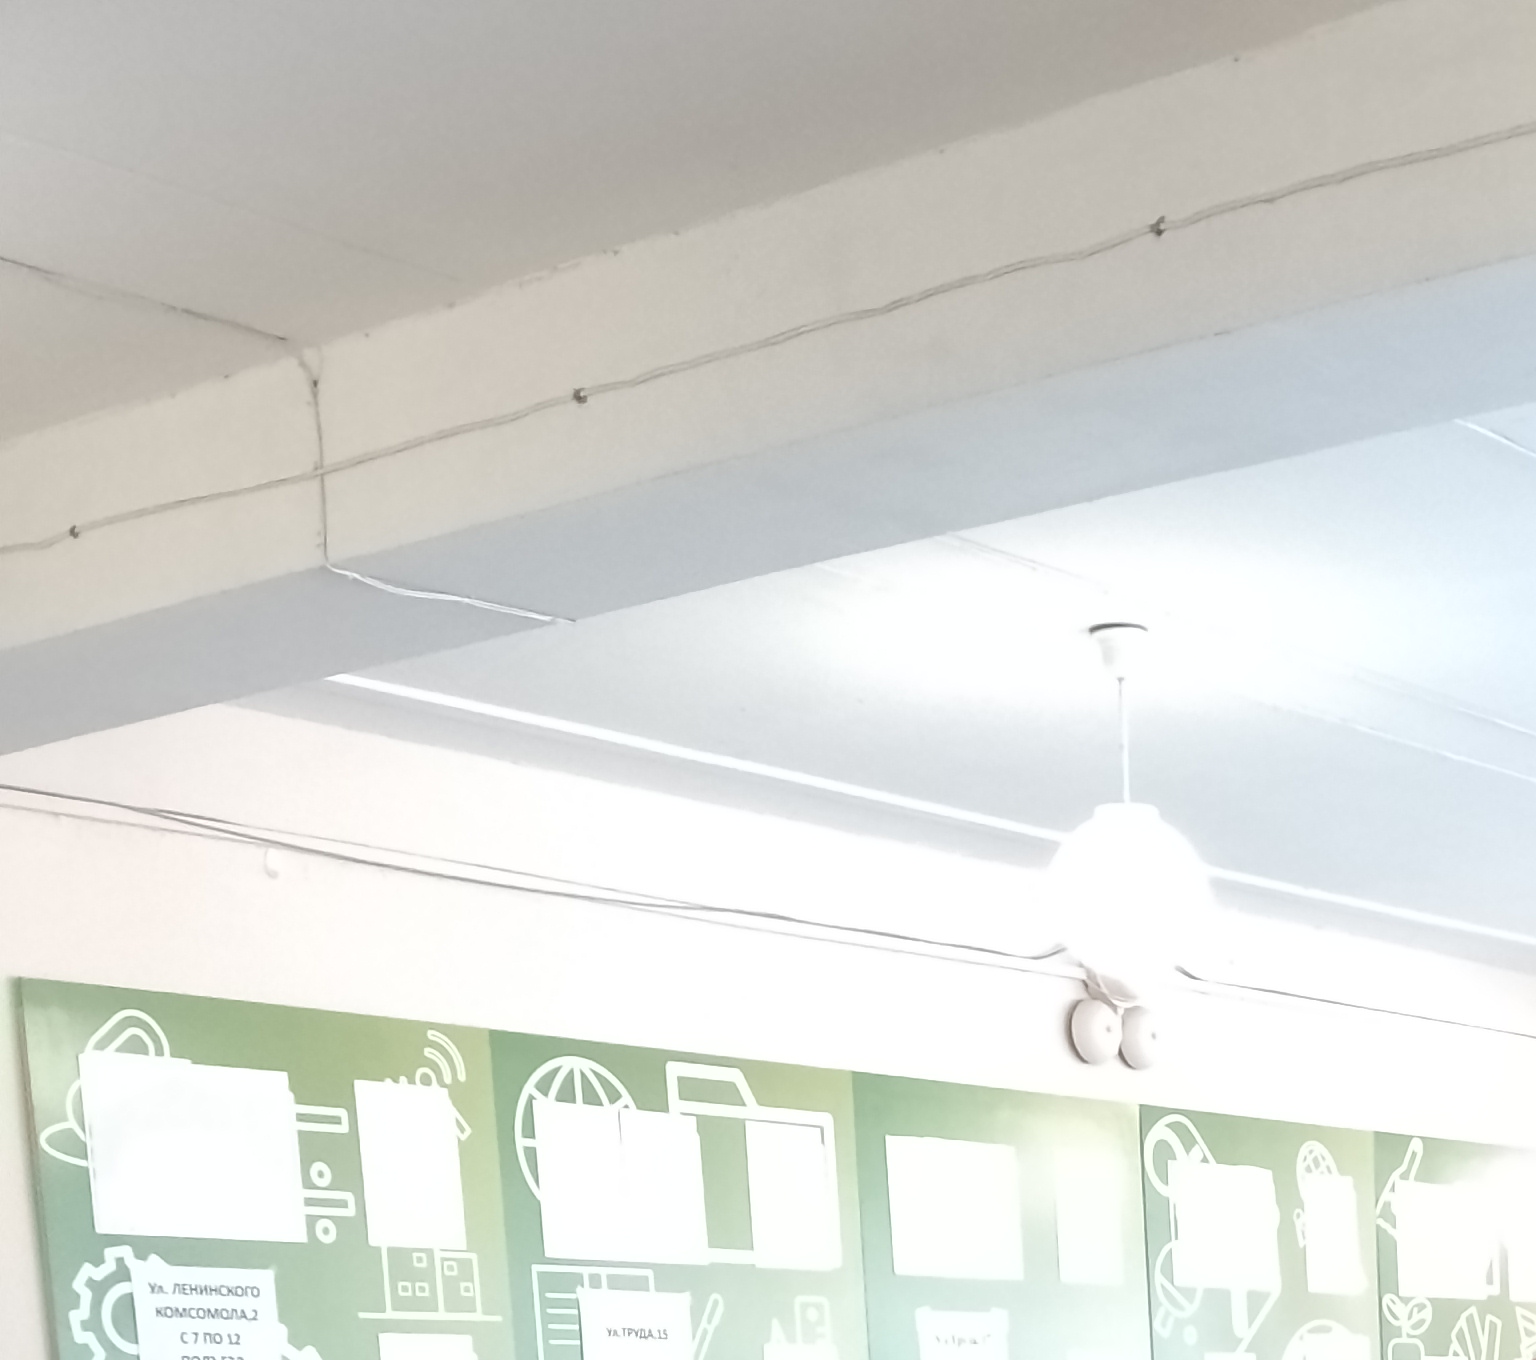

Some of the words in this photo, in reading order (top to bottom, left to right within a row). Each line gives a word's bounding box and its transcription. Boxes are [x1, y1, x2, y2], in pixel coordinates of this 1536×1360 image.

[147, 1282, 169, 1295] Ул.
[172, 1283, 260, 1298] ЛЕНИНСКОГО
[180, 1331, 189, 1345] С
[191, 1331, 199, 1345] 7
[203, 1332, 223, 1345] ПО
[227, 1333, 241, 1345] 12
